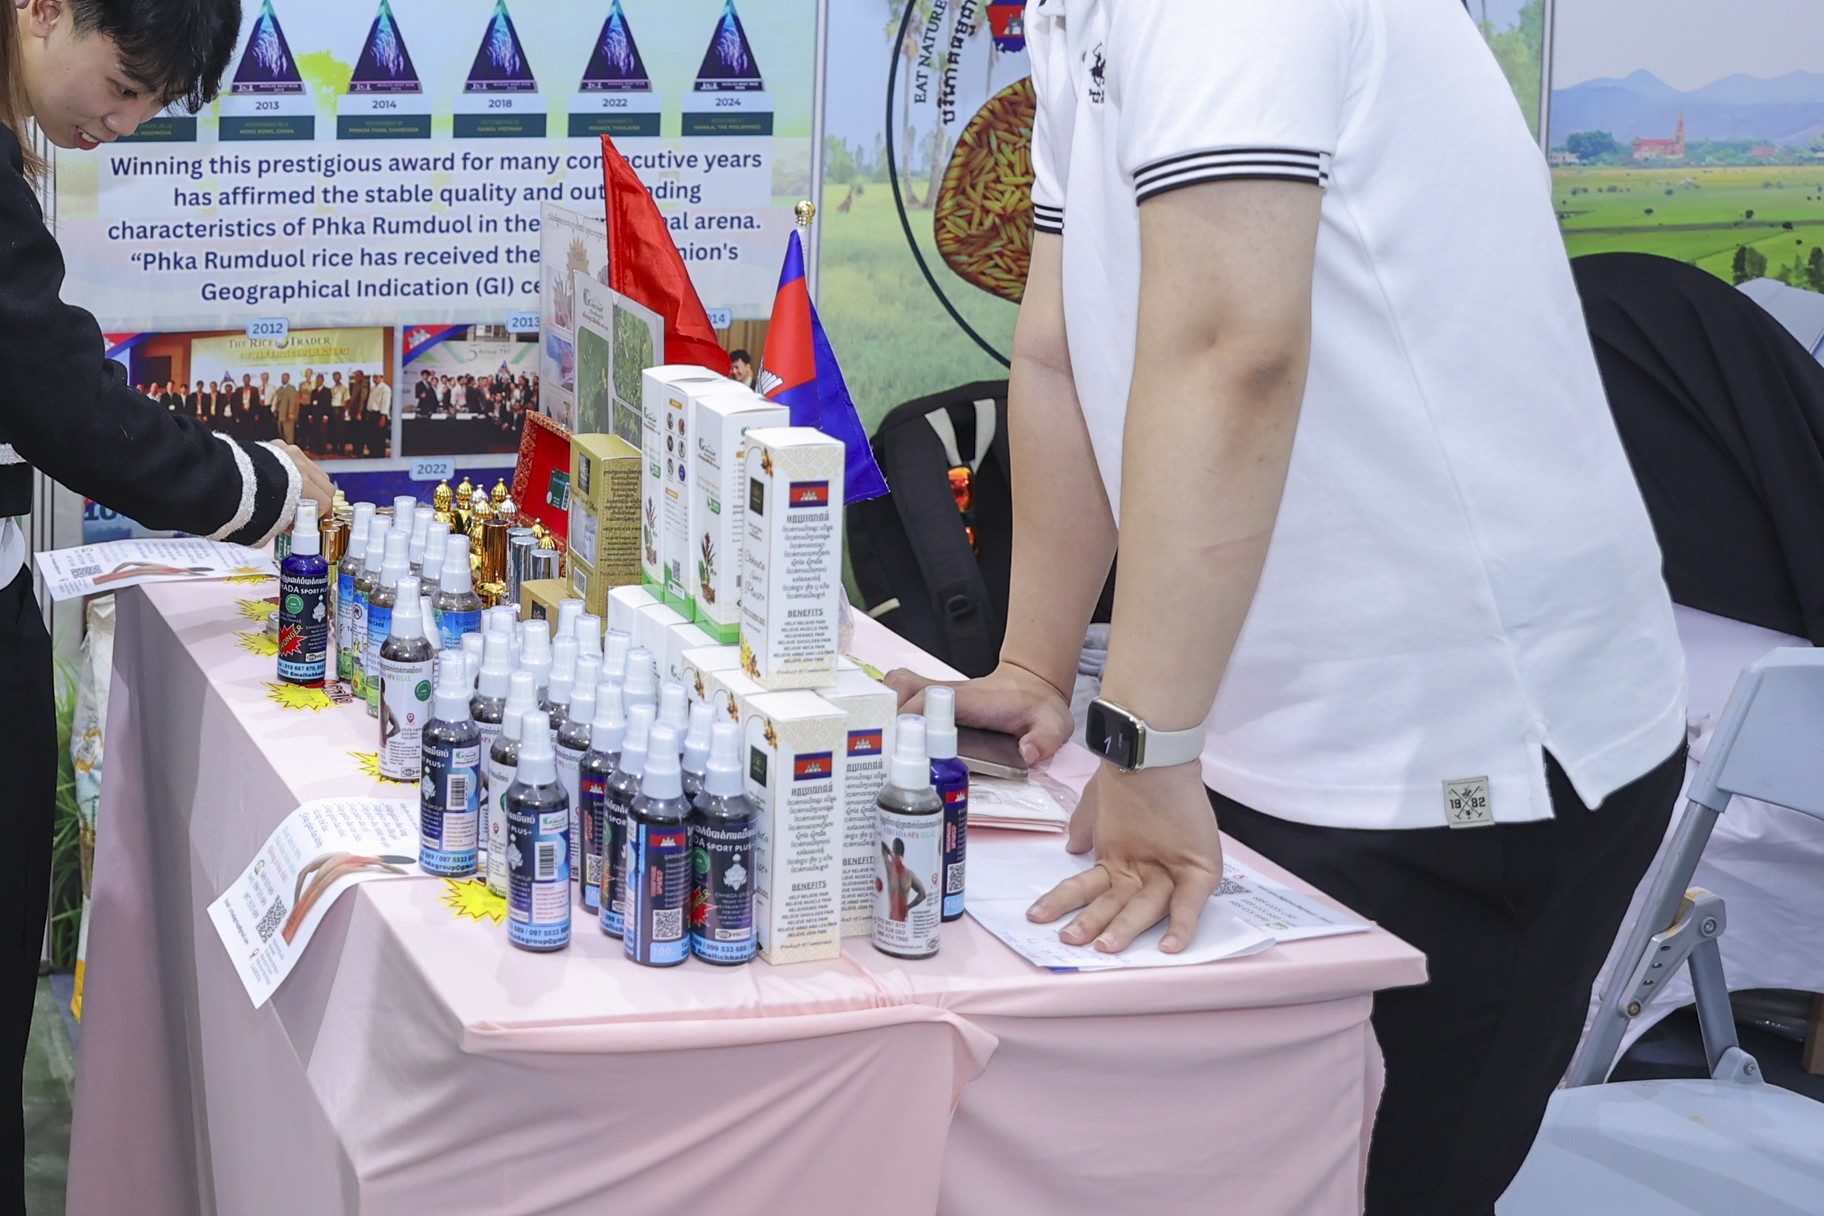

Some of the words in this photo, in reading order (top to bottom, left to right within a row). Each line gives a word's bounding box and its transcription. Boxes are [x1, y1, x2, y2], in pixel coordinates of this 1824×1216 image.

[914, 71, 928, 104] EAT
[255, 101, 279, 110] 2013
[372, 100, 397, 109] 2014
[488, 99, 512, 108] 2018
[602, 98, 627, 107] 2022
[715, 98, 741, 107] 2024
[110, 155, 203, 180] Winning
[208, 154, 252, 176] this
[258, 154, 382, 178] prestigious
[389, 153, 454, 171] award
[462, 152, 494, 170] for
[500, 156, 560, 175] many
[704, 154, 762, 173] years
[174, 188, 212, 206] has
[219, 185, 315, 205] affirmed
[322, 185, 358, 204] the
[365, 184, 433, 203] stable
[440, 183, 517, 207] quality
[523, 182, 563, 201] and
[108, 218, 276, 240] characteristics
[283, 217, 306, 236] of
[313, 217, 366, 235] Phka
[373, 215, 472, 234] Rumduol
[479, 214, 497, 233] in
[504, 214, 540, 232] the
[695, 216, 760, 230] arena.
[131, 251, 197, 271] “Phka
[205, 249, 305, 269] Rumduol
[312, 248, 353, 267] rice
[361, 248, 397, 266] has
[405, 245, 498, 265] received
[505, 245, 540, 263] the
[677, 240, 738, 263] nion's
[202, 279, 350, 305] Geographical
[357, 278, 468, 297] Indication
[476, 276, 514, 297] (GI)
[252, 322, 283, 336] 2012
[229, 339, 246, 349] THE
[250, 338, 274, 348] RICE
[291, 337, 330, 347] TRADER
[417, 463, 447, 476] 2022
[787, 609, 824, 618] BENEFITS
[706, 843, 733, 853] SPORT
[791, 881, 827, 891] BENEFITS
